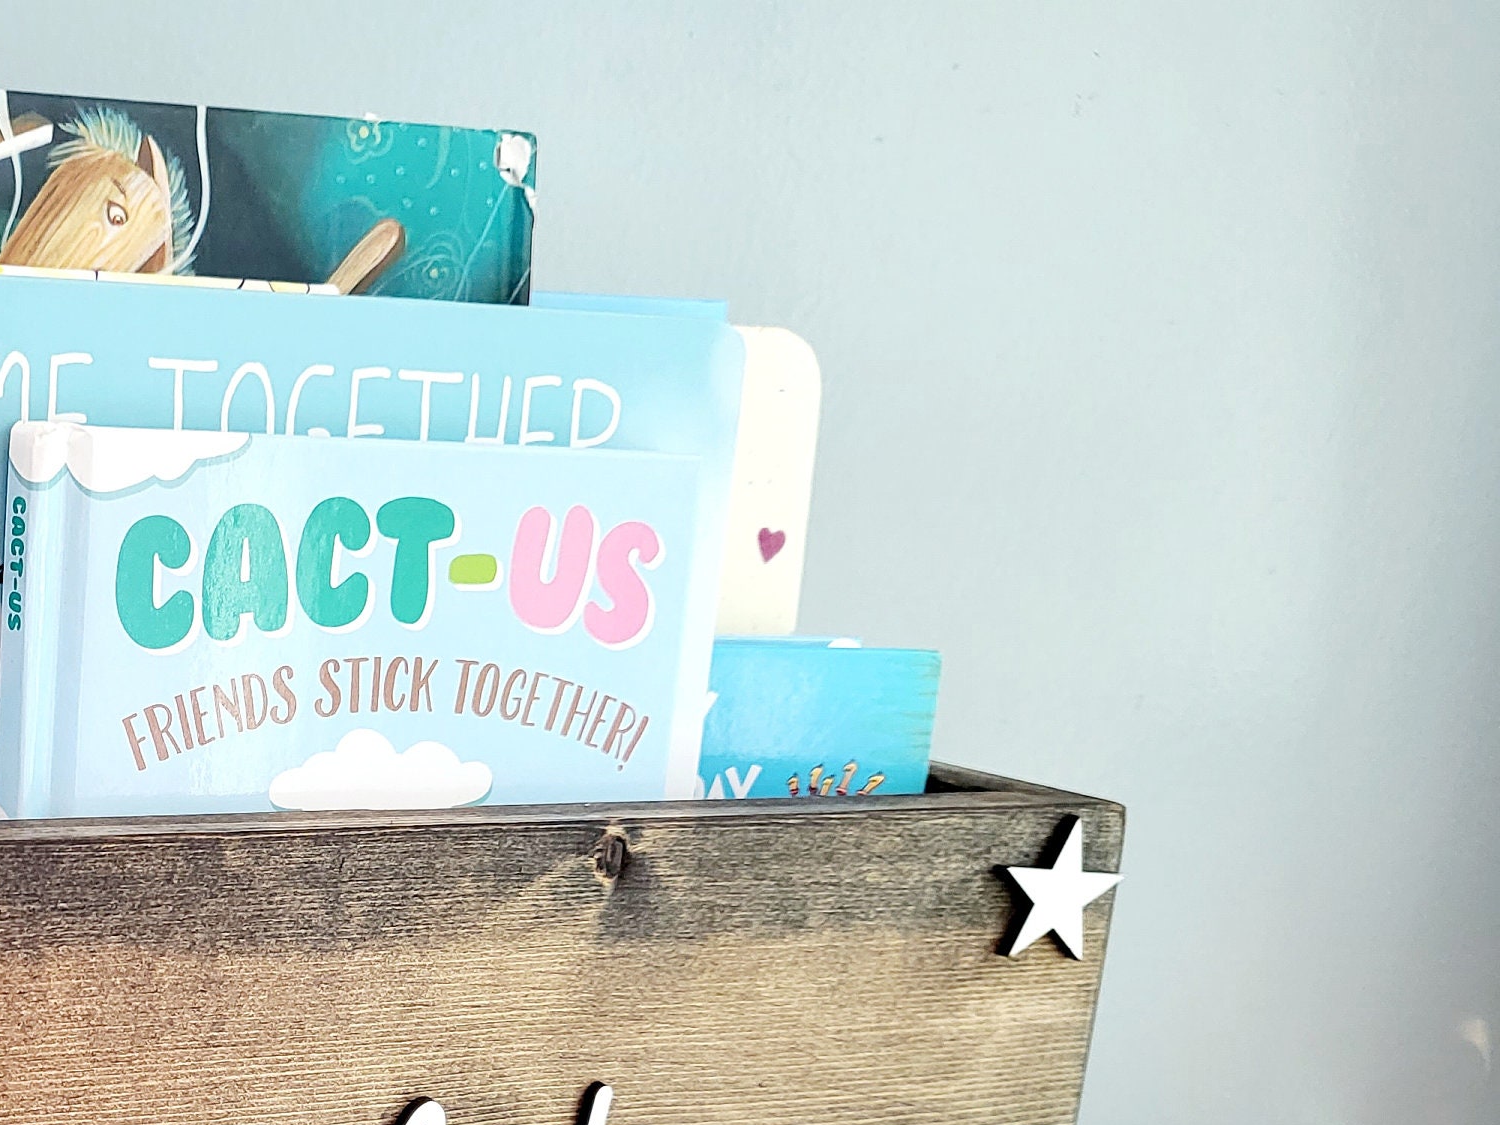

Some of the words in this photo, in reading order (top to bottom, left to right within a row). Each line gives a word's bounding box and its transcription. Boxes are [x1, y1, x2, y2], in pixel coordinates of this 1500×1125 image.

[7, 496, 27, 631] CACT-US
[114, 496, 666, 650] CACT-US
[121, 665, 296, 772] FRIENDS
[313, 656, 440, 718] STICK
[453, 658, 650, 772] TOGETHER!
